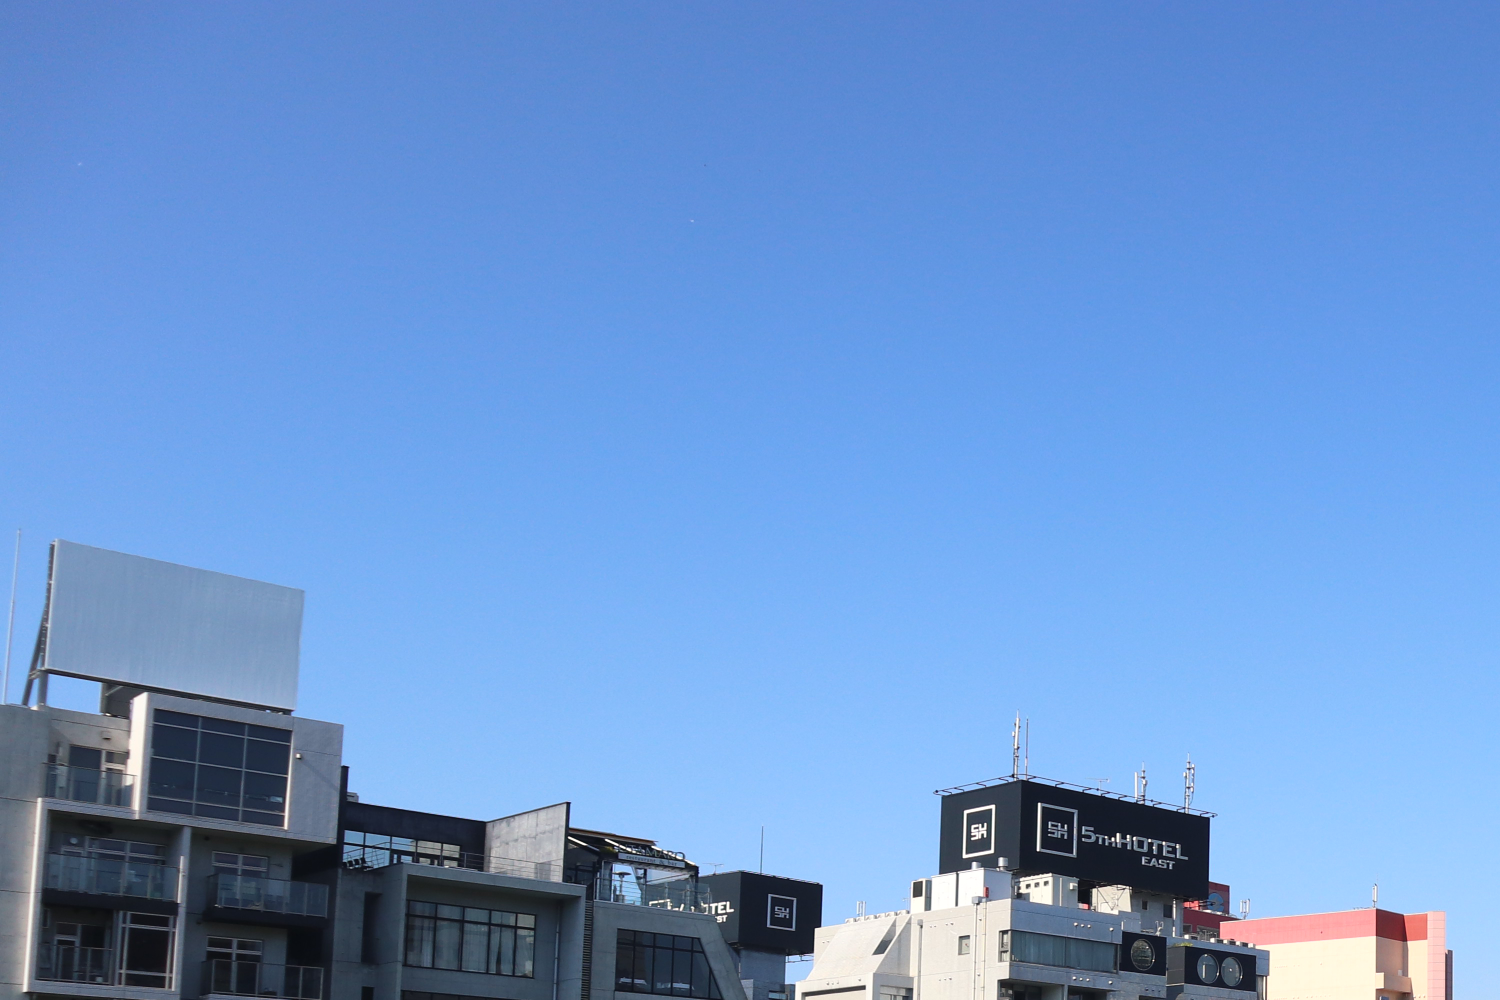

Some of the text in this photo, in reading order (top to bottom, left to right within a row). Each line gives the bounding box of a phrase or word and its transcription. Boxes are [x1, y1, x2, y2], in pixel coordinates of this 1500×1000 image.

[1116, 832, 1188, 861] HOTEL
[626, 855, 656, 863] restaurant
[1141, 856, 1176, 870] EAST
